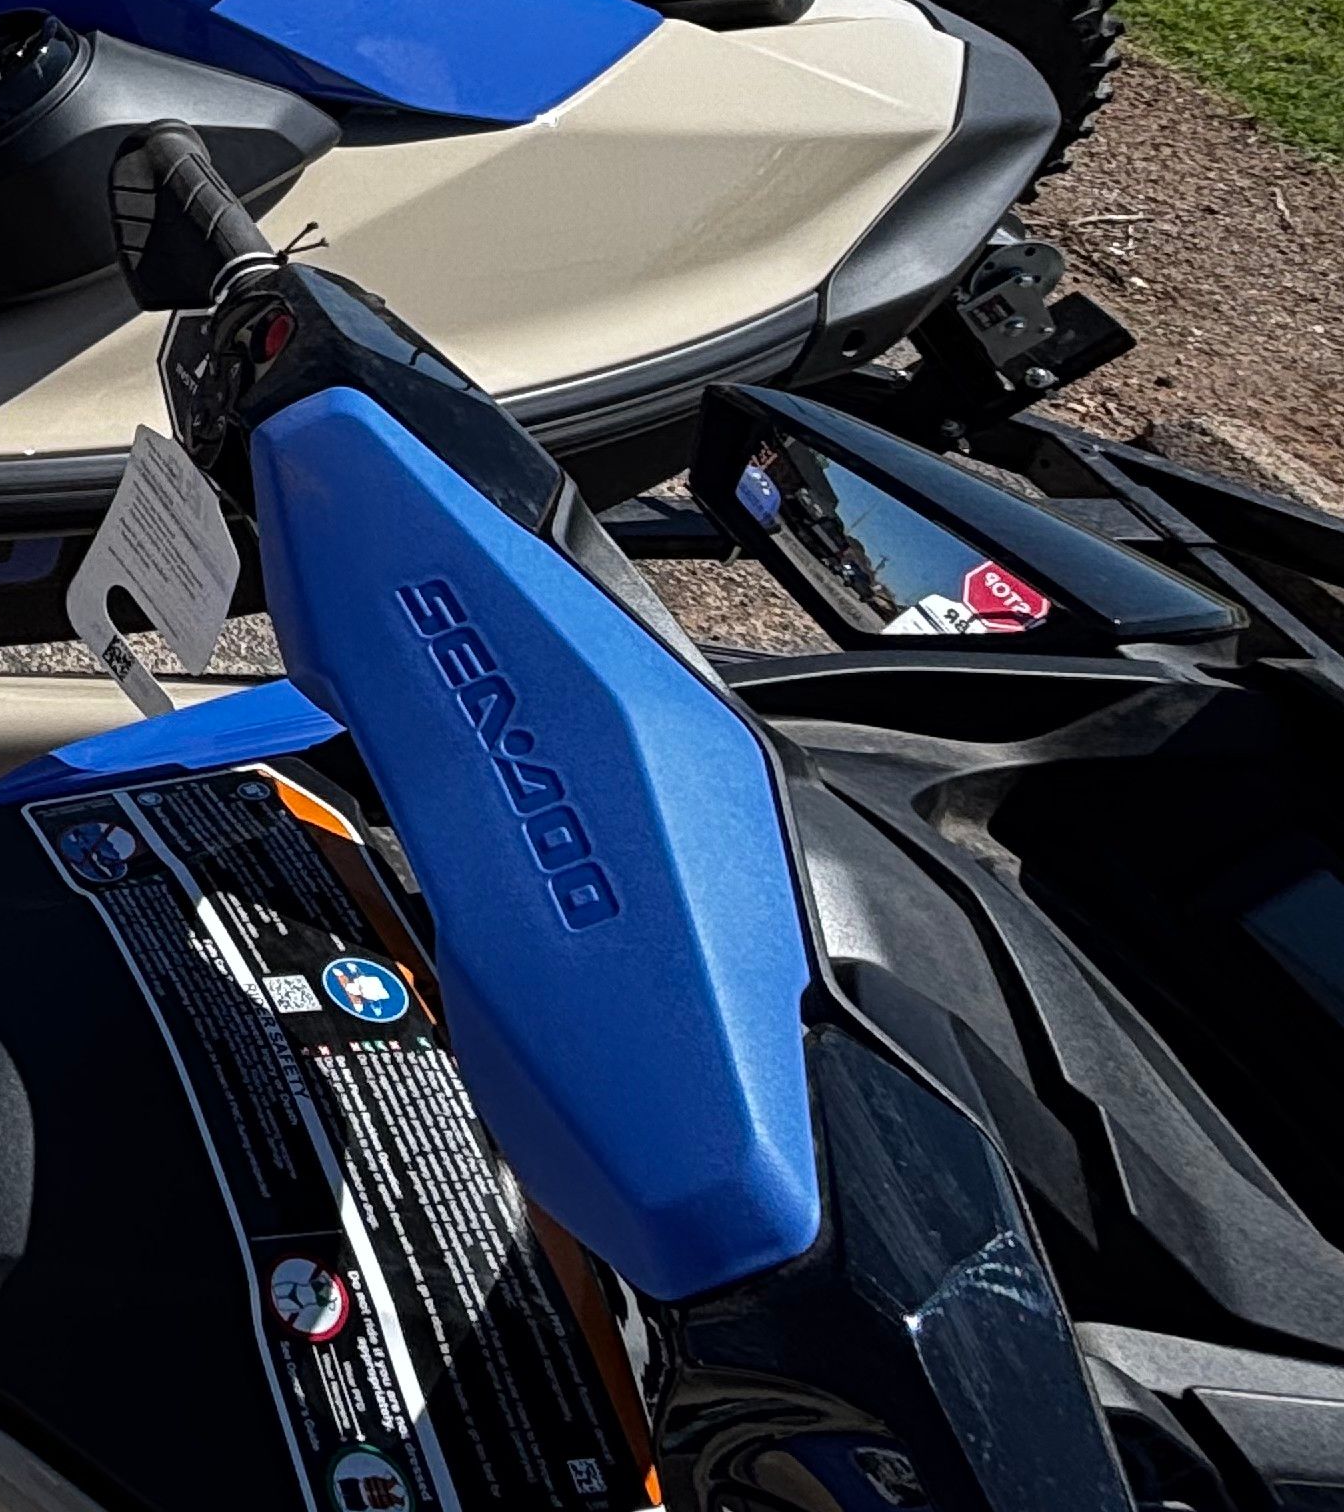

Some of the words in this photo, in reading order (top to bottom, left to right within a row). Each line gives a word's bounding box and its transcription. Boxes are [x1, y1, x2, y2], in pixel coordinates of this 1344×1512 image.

[246, 983, 277, 1030] RIDER
[269, 1030, 307, 1101] SAFETY
[356, 1291, 370, 1315] not
[374, 1359, 392, 1387] you
[386, 1389, 401, 1413] are
